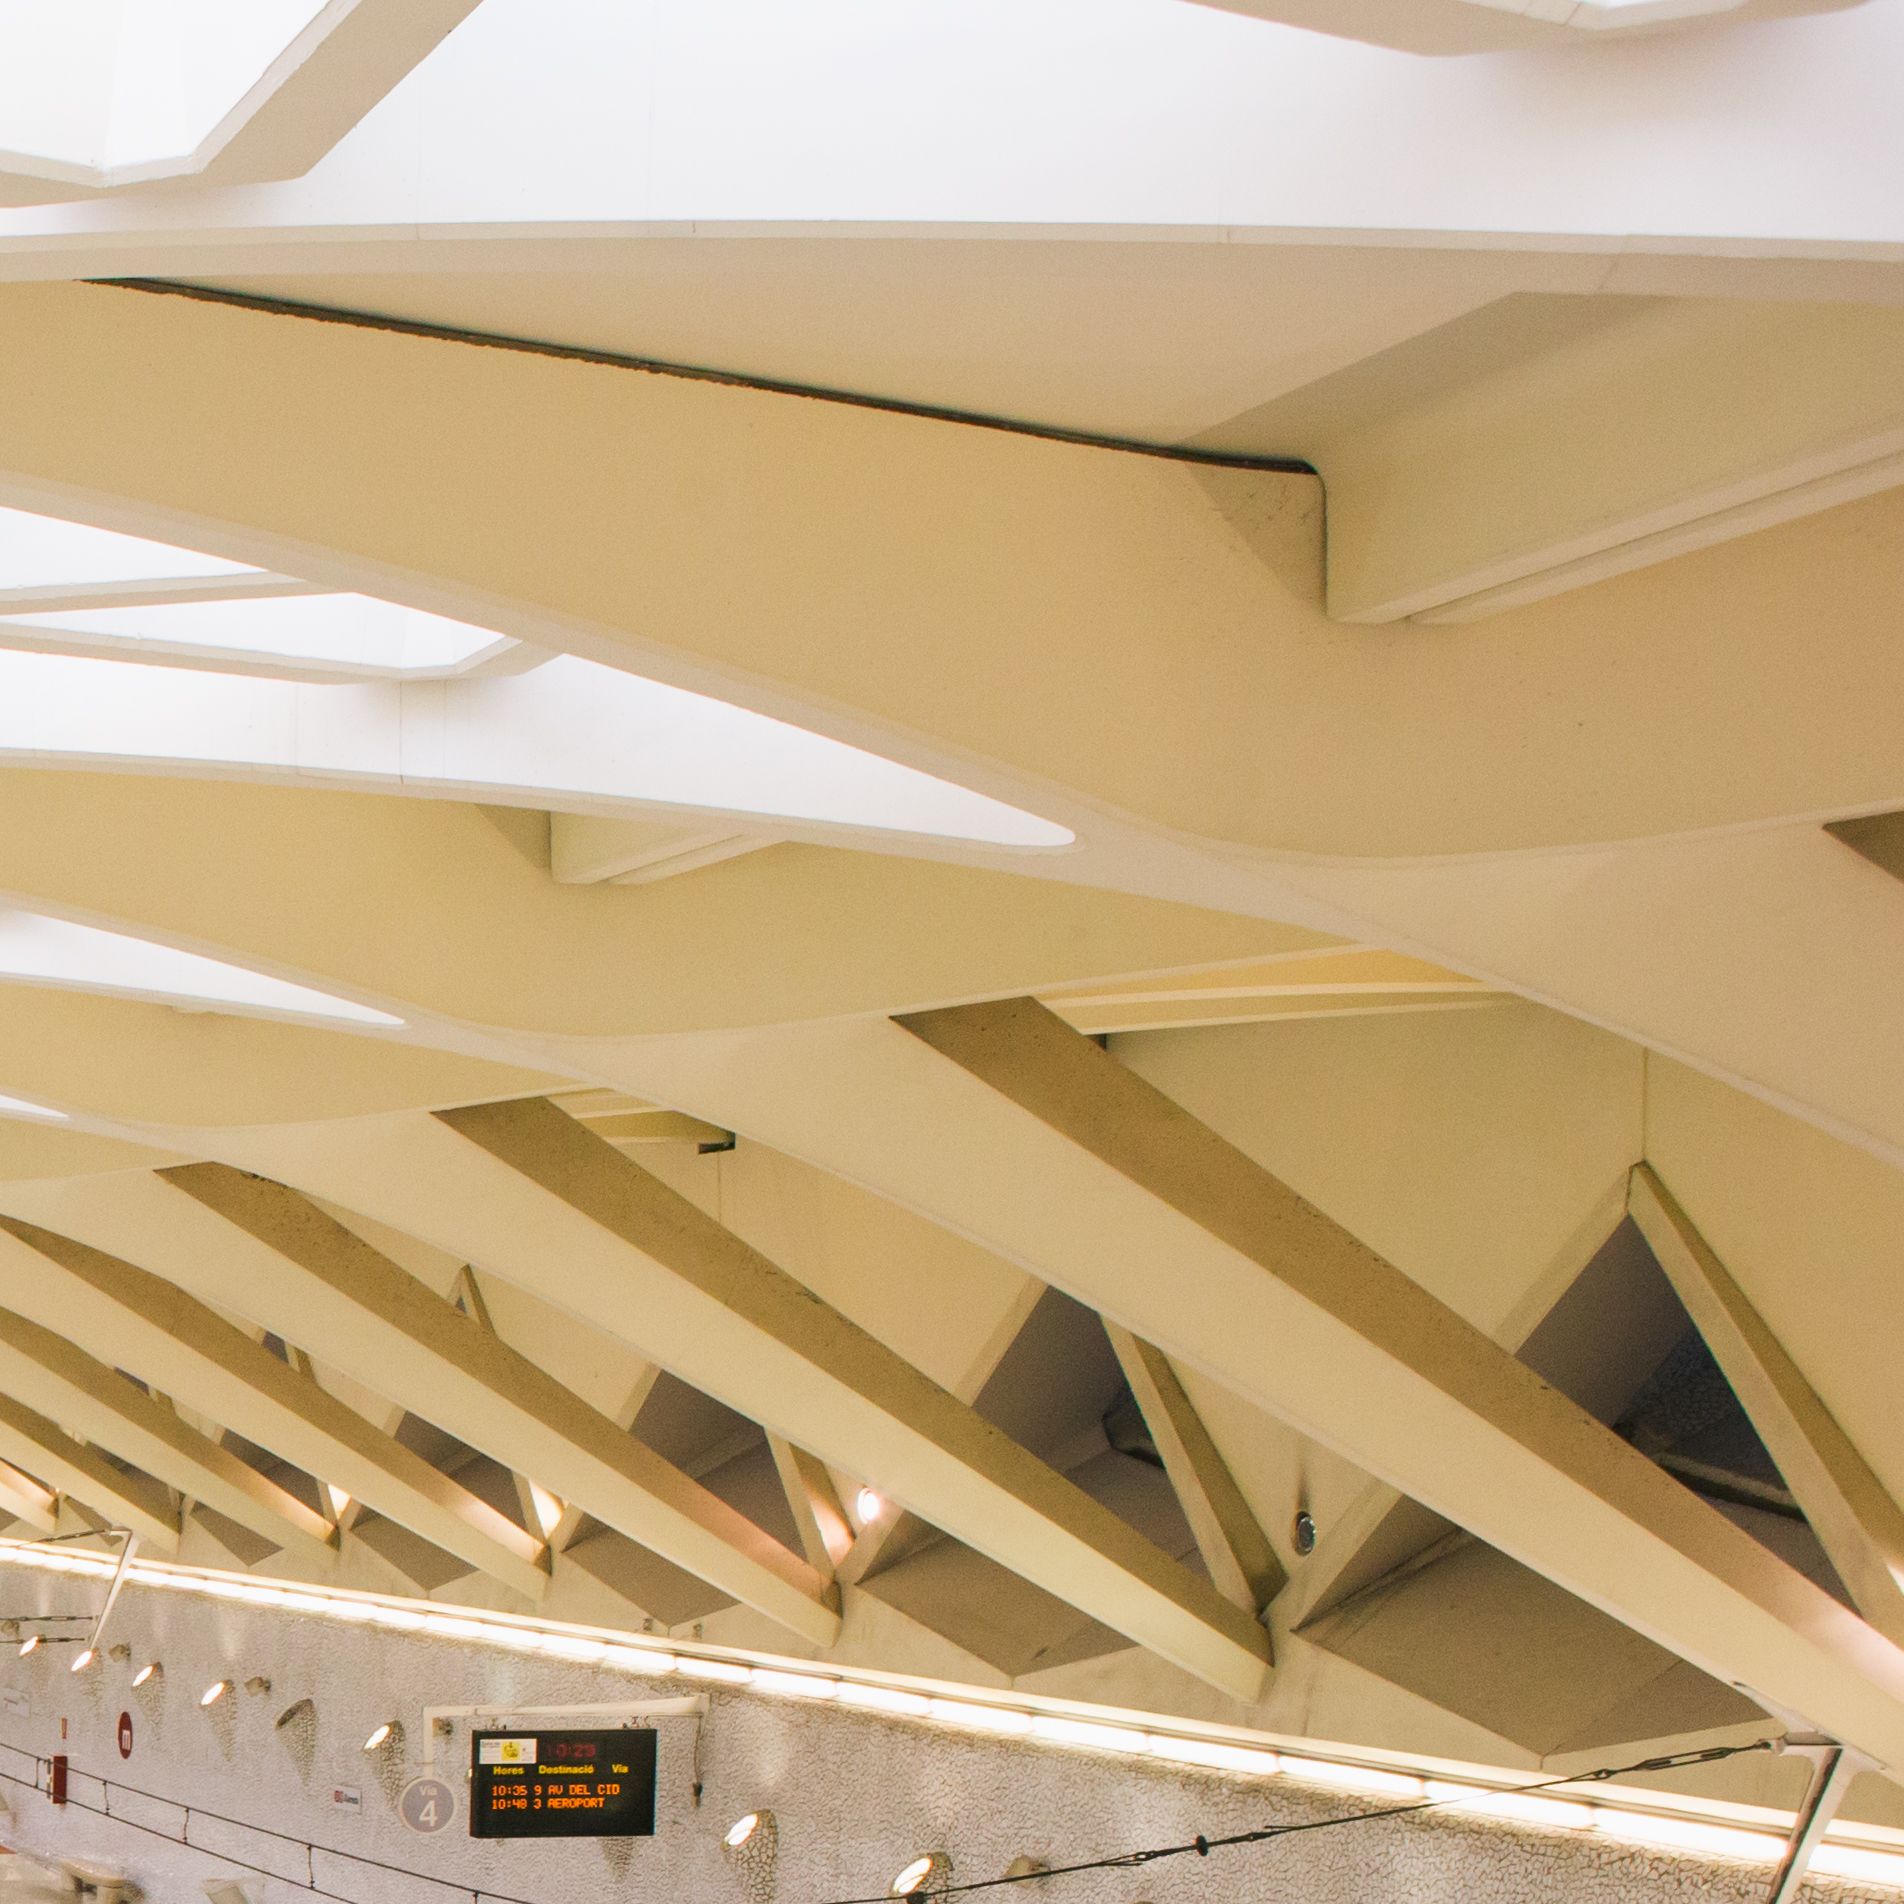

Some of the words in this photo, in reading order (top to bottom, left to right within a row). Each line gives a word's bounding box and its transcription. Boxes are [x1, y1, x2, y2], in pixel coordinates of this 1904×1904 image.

[493, 1765, 524, 1775] Hores
[538, 1764, 594, 1774] Destinació
[612, 1763, 629, 1773] Via
[419, 1785, 438, 1796] Via
[492, 1785, 528, 1796] 10:35
[534, 1785, 542, 1795] 9
[548, 1785, 563, 1795] AV
[569, 1784, 591, 1795] DEL
[597, 1784, 620, 1794] CID
[533, 1799, 542, 1809] 3
[547, 1797, 605, 1809] AEROPORT
[419, 1799, 438, 1827] 4
